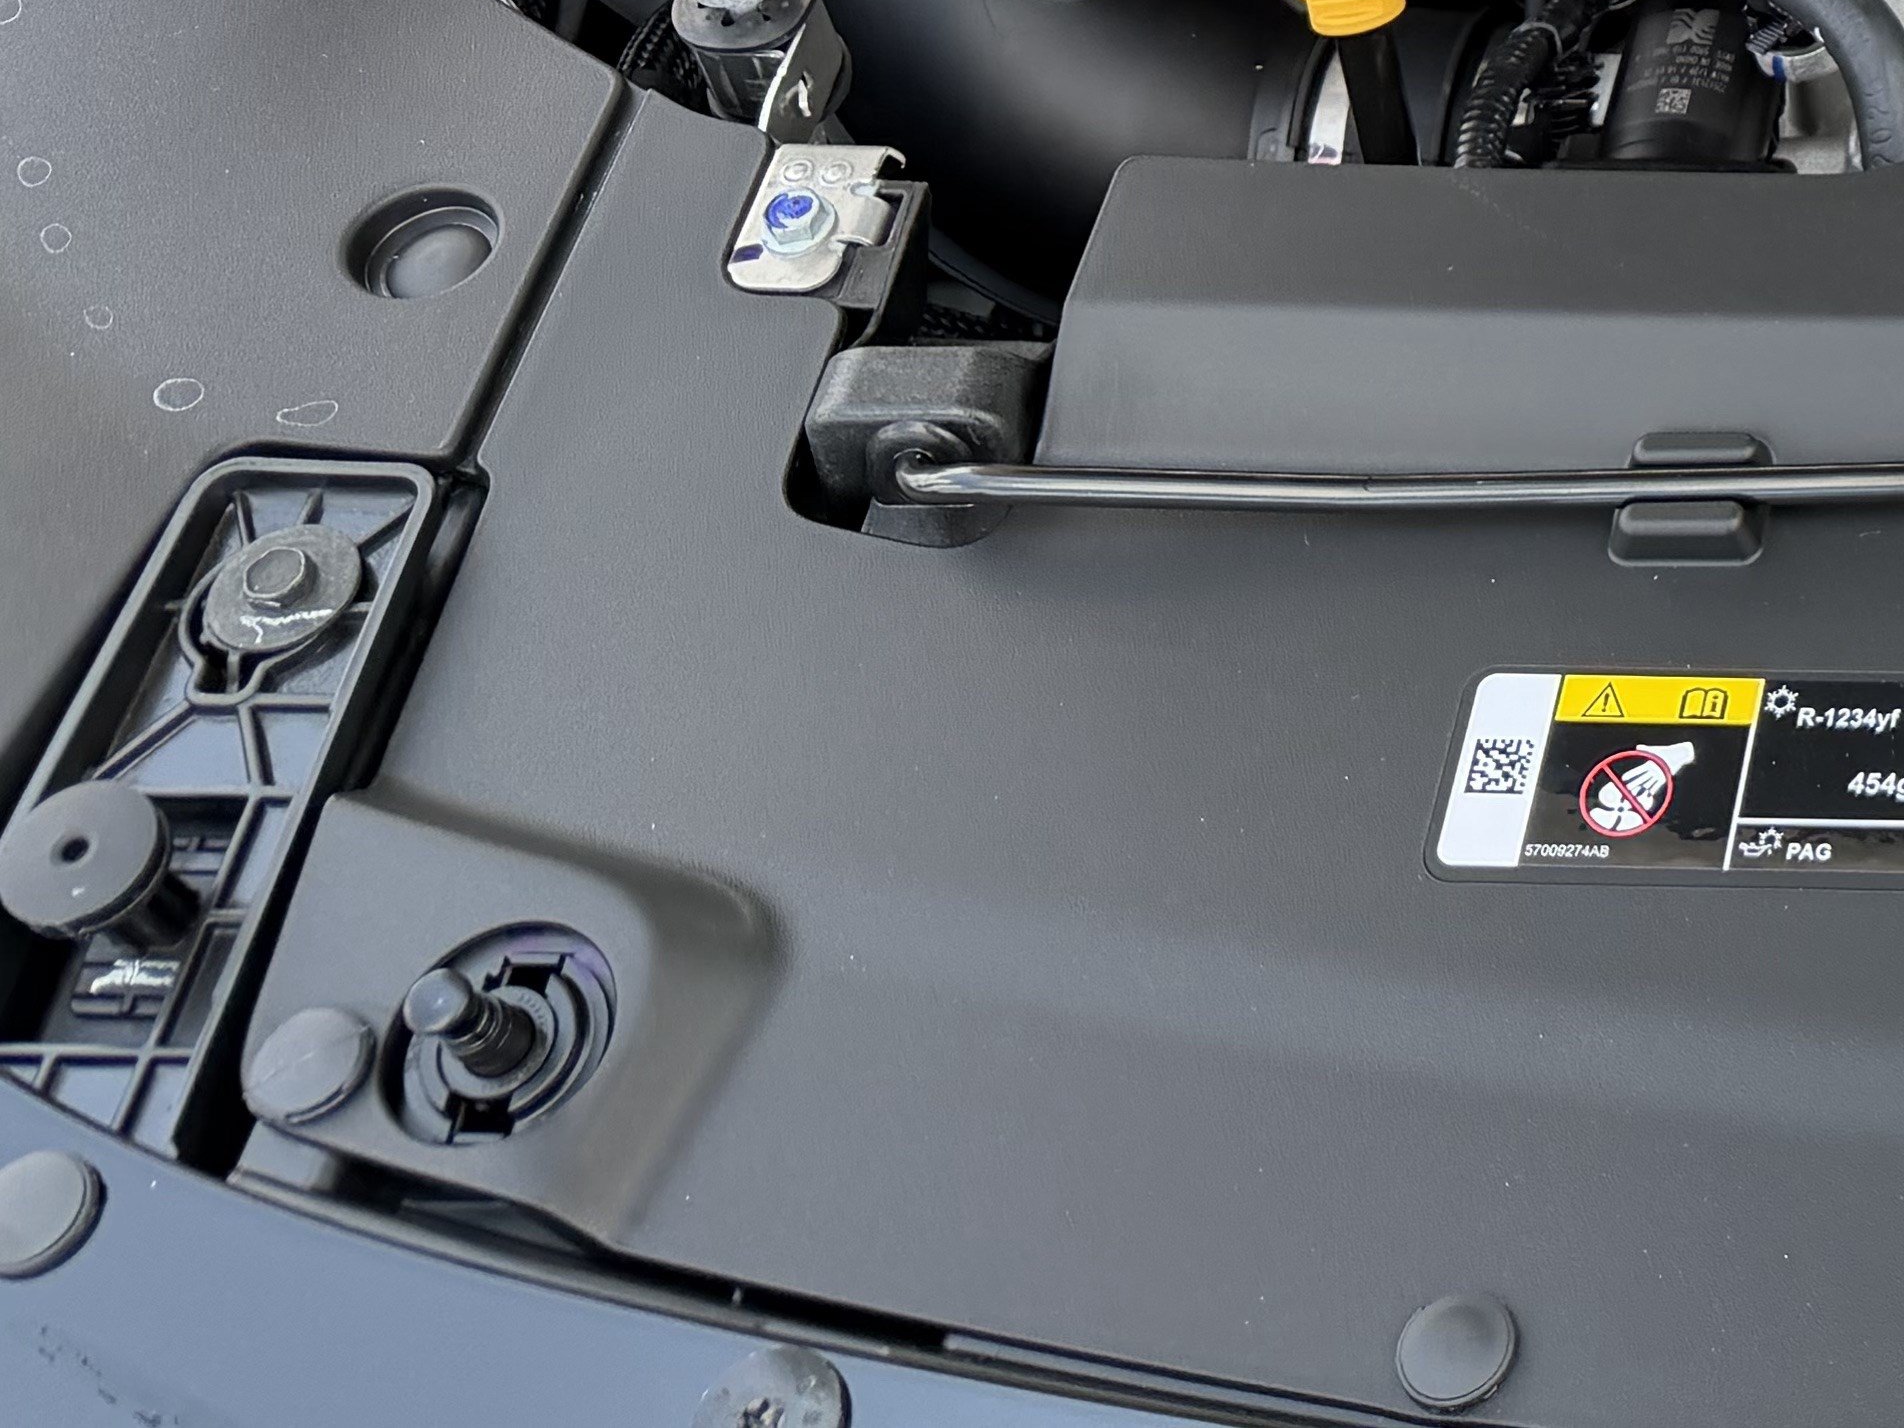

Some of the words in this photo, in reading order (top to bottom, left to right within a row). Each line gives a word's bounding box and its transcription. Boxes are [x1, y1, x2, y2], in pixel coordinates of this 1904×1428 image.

[1796, 707, 1901, 733] R-1234yf
[1524, 844, 1610, 859] 57009274AB
[1786, 840, 1833, 862] PAG
